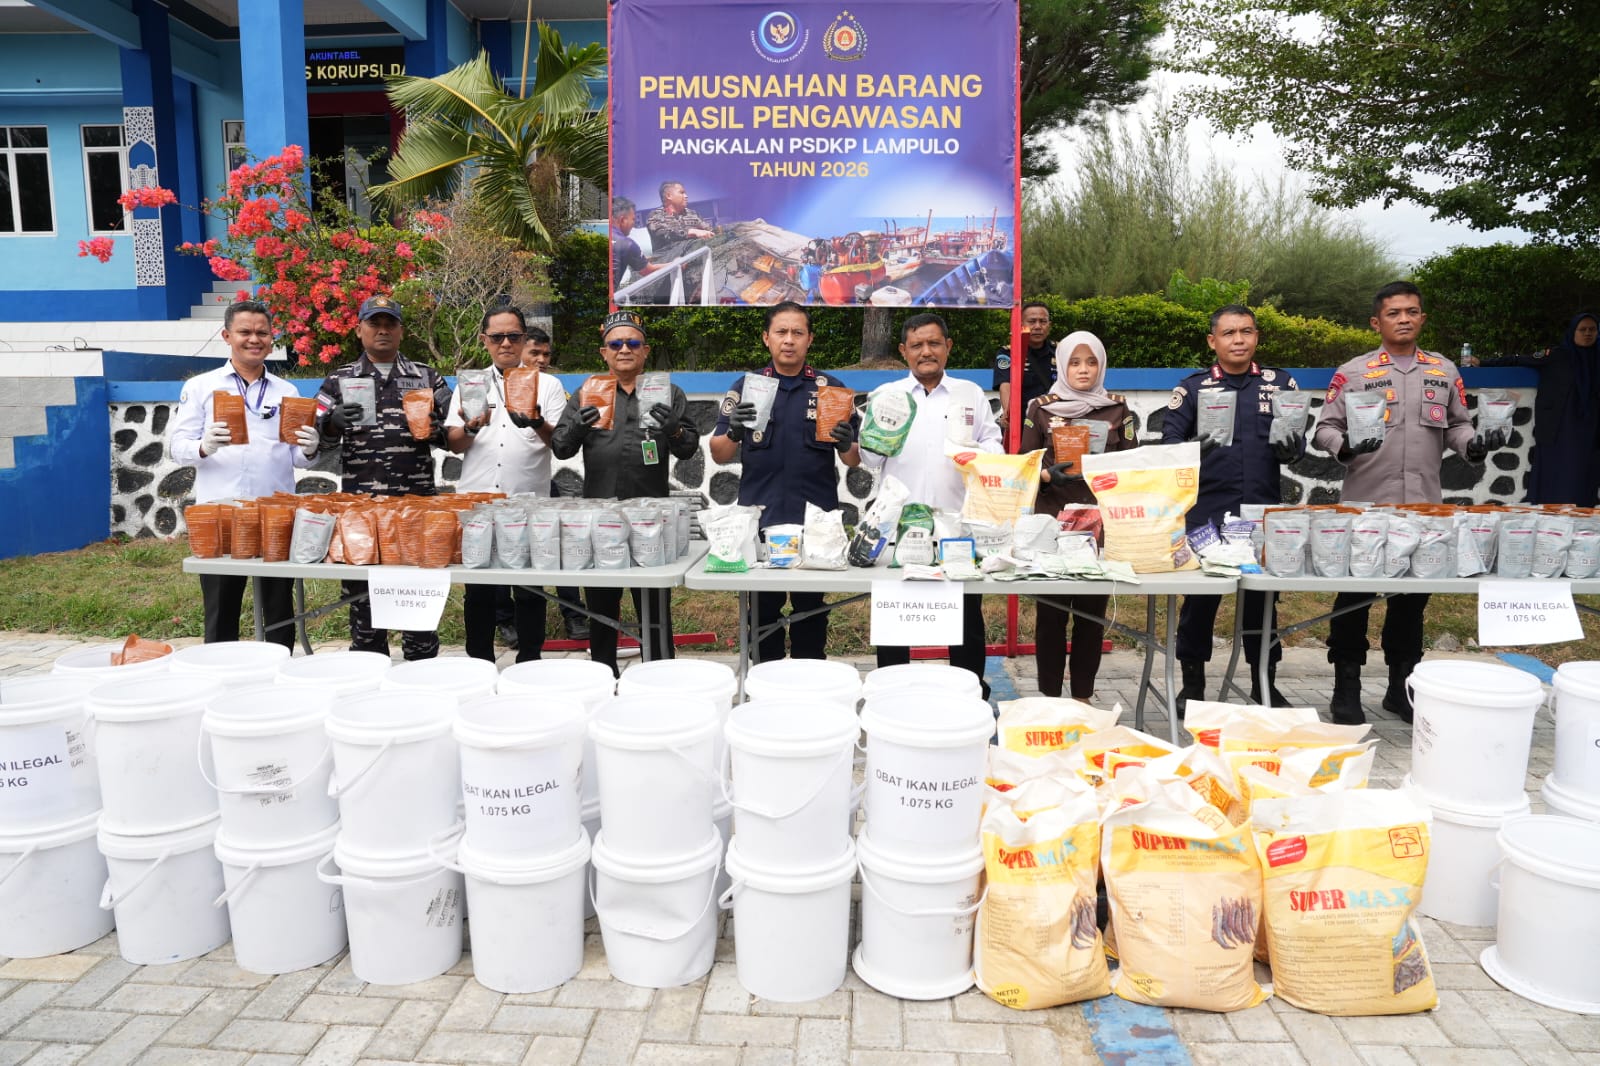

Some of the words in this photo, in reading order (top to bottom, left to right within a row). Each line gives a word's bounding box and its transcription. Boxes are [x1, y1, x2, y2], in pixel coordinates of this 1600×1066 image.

[310, 52, 360, 60] AKUNTABEL
[317, 64, 384, 80] KORUPSI
[639, 75, 848, 99] PEMUSNAHAN
[856, 74, 983, 98] BARANG
[659, 106, 744, 130] HASIL
[753, 105, 962, 129] PENGAWASAN
[661, 139, 784, 155] PANGKALAN
[790, 138, 857, 155] PSDKP
[863, 138, 960, 155] LAMPULO
[750, 162, 816, 178] TAHUN
[820, 162, 869, 178] 2026
[1424, 378, 1448, 388] POLRI
[1108, 505, 1144, 520] SUPER
[398, 588, 416, 596] IKAN
[418, 589, 446, 598] ILEGAL
[902, 602, 924, 610] IKAN
[926, 602, 958, 610] ILEGAL
[1483, 602, 1508, 610] OBAT
[1026, 730, 1063, 746] SUPER
[10, 754, 62, 771] ILEGAL
[8, 776, 28, 788] KG
[876, 768, 903, 786] OBAT
[906, 780, 938, 791] IKAN
[942, 776, 978, 792] ILEGAL
[482, 788, 510, 799] IKAN
[514, 779, 560, 798] ILEGAL
[480, 806, 508, 816] 1.075
[512, 804, 531, 816] KG
[900, 796, 931, 808] 1.075
[935, 799, 954, 808] KG
[1132, 830, 1187, 850] SUPER
[1290, 888, 1346, 912] SUPER
[1347, 886, 1412, 908] MAX
[996, 988, 1020, 996] NETTO
